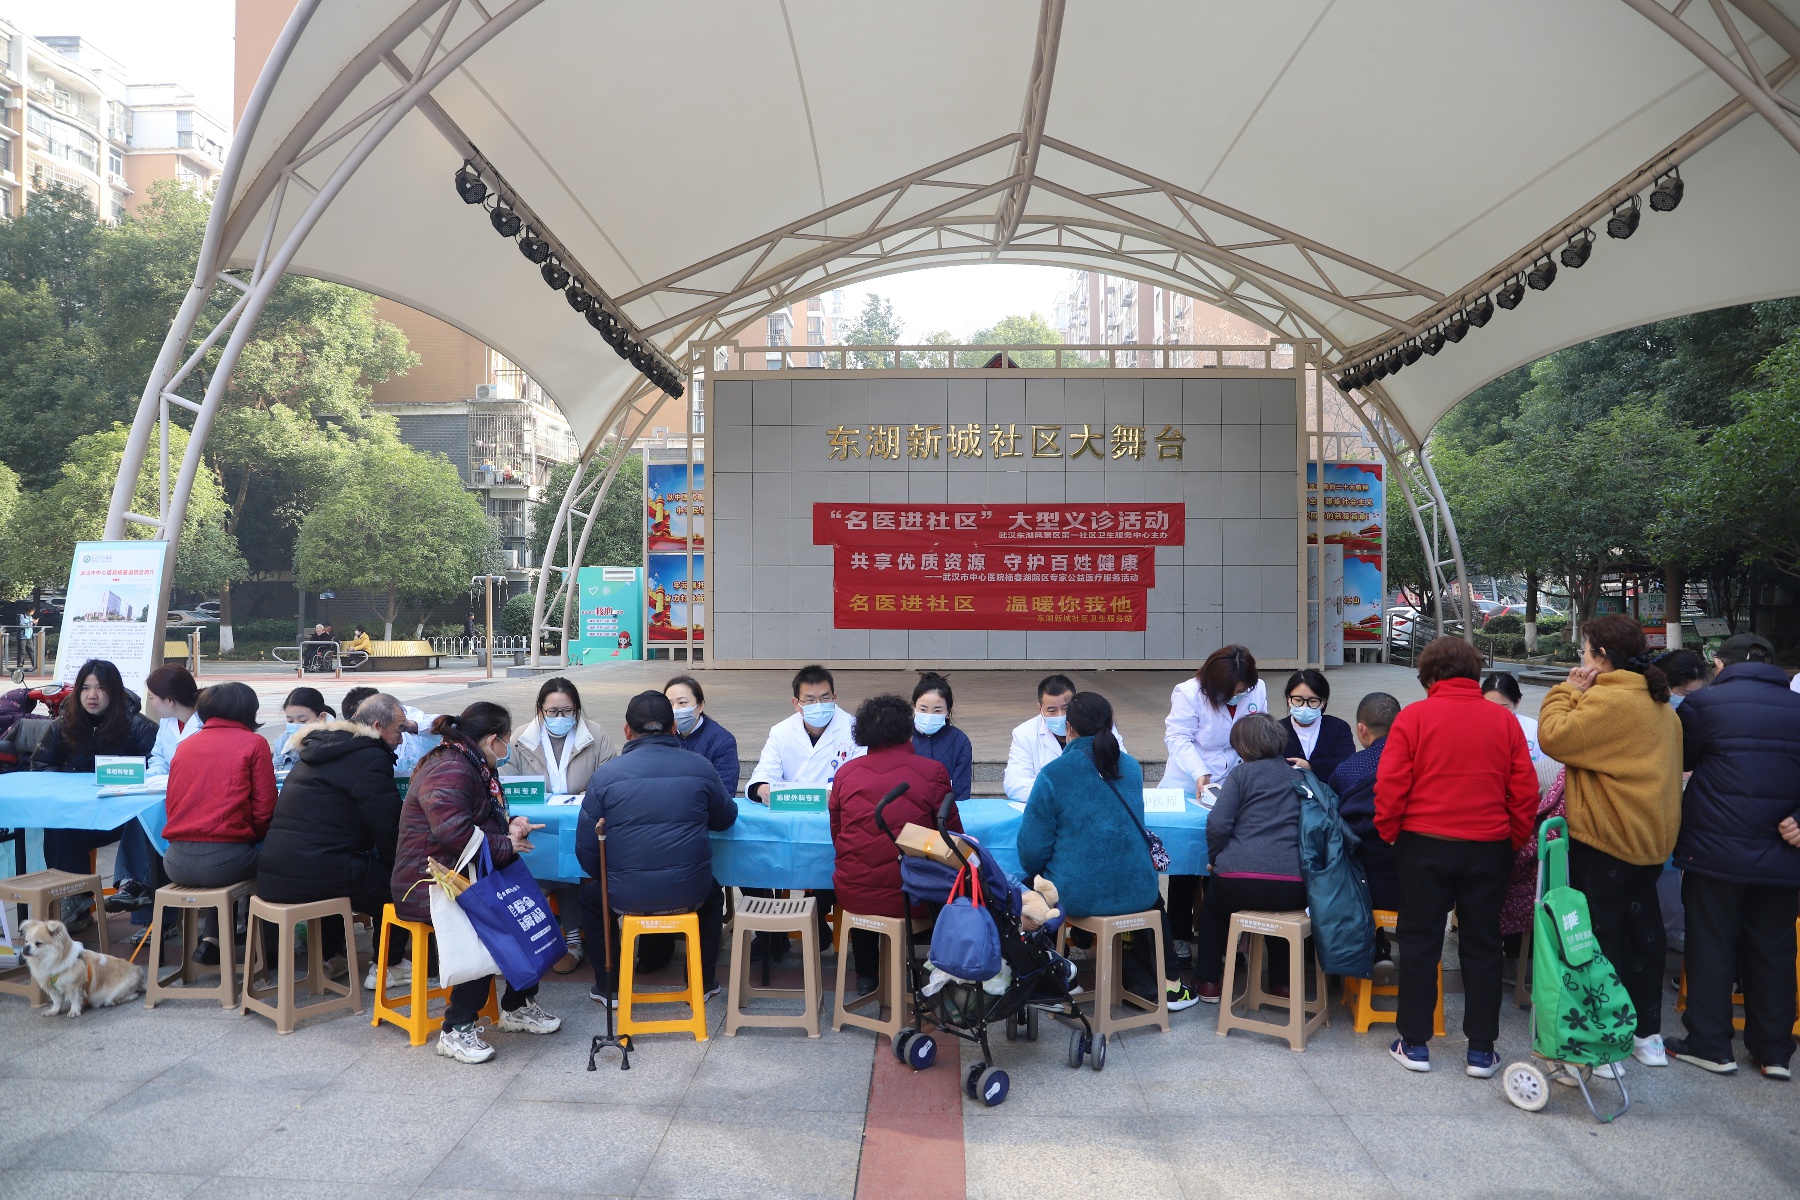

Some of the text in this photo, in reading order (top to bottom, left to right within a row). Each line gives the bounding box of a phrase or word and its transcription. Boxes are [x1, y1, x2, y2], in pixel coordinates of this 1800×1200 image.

[826, 423, 1187, 462] 东湖新城社区大舞台
[830, 510, 1169, 531] “名医进社区” 大型义诊活动
[998, 531, 1169, 540] 武汉东湖风景区第一社区卫生服务中心主办
[850, 552, 1139, 572] 共享优质资源 守护百姓健康
[848, 593, 1133, 613] 名医进社区 温暖你我他
[776, 793, 820, 802] 泌尿外科专家
